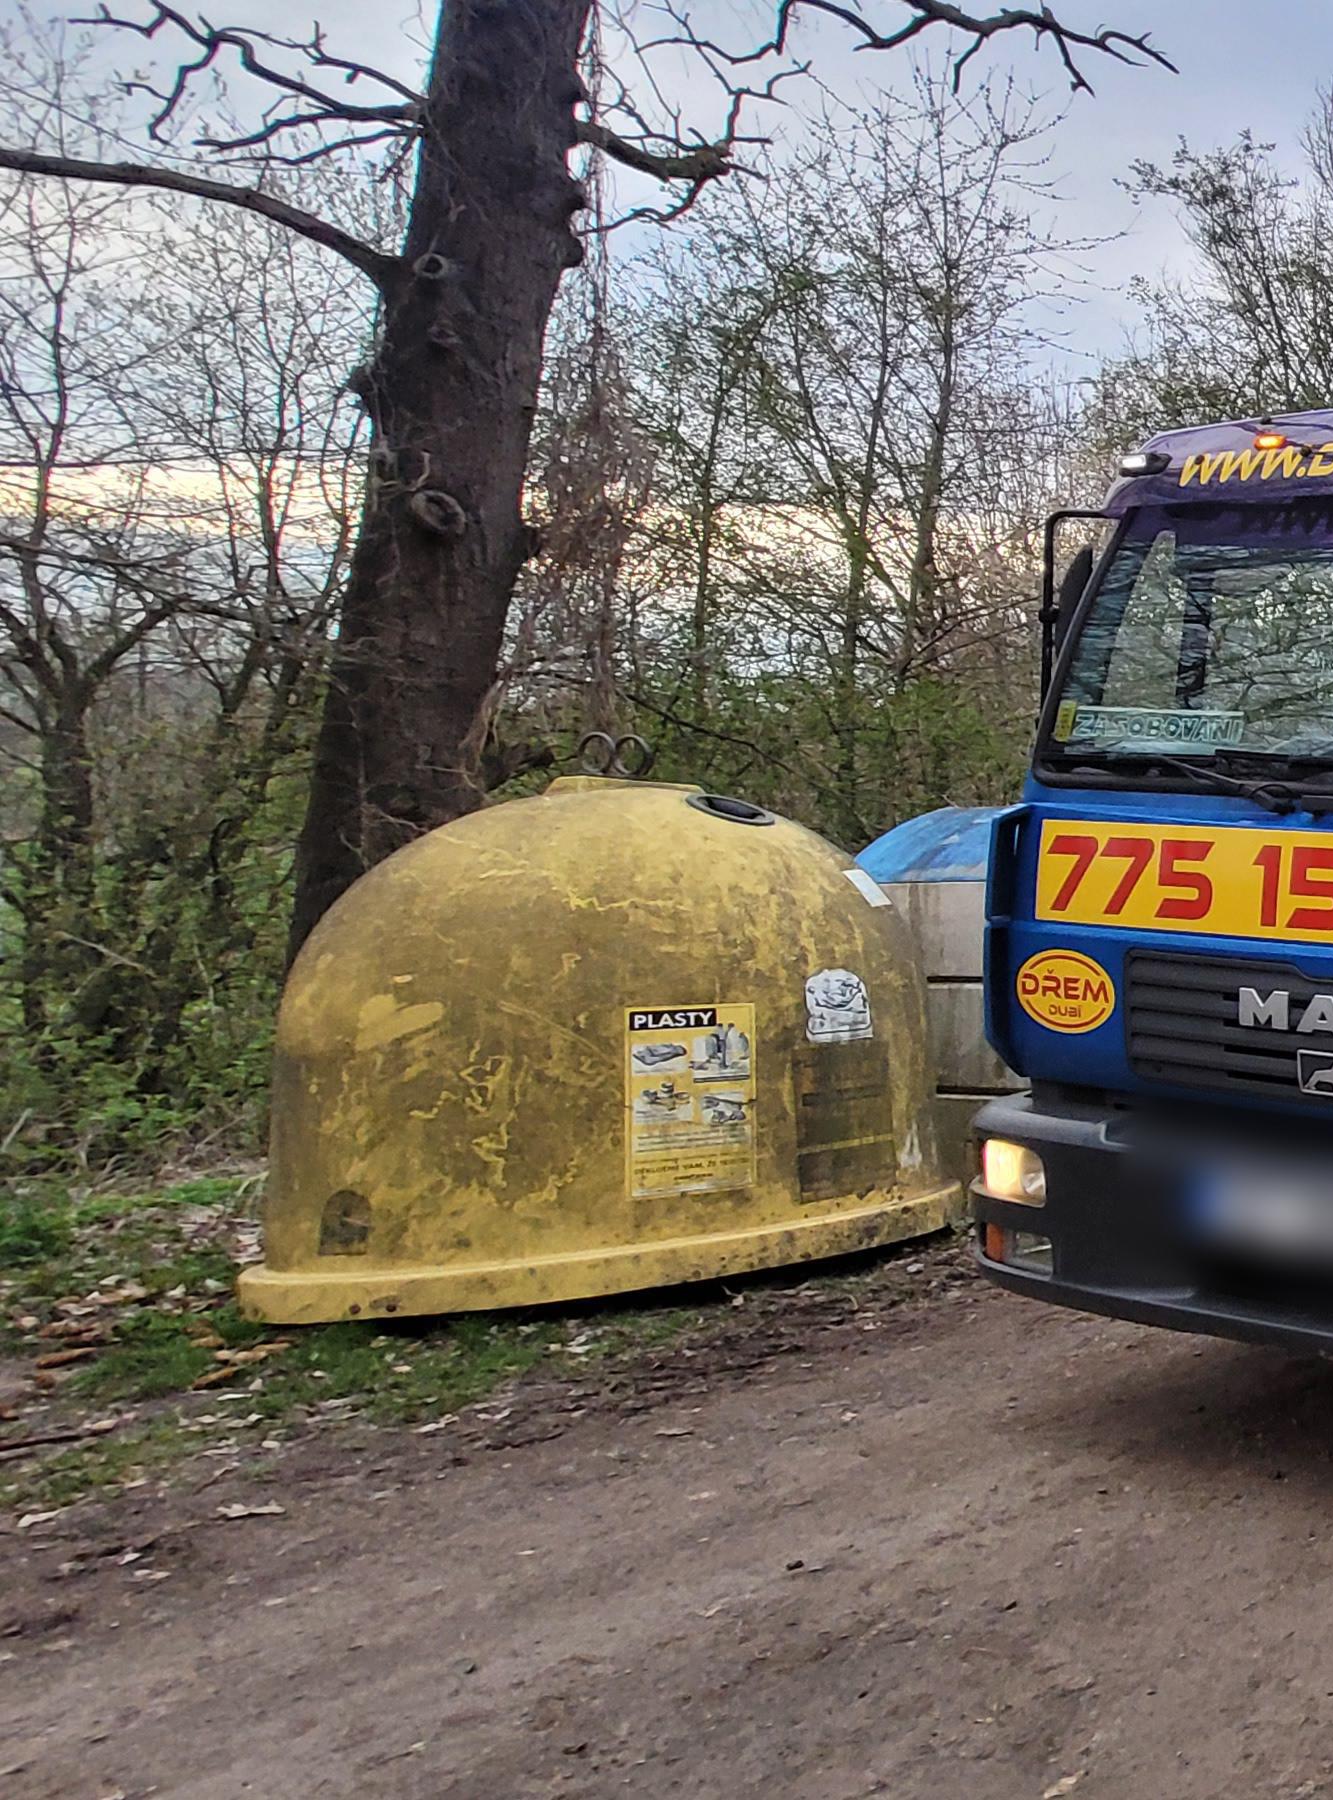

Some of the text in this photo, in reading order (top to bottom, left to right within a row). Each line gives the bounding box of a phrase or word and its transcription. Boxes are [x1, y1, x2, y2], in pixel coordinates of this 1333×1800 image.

[1046, 835, 1216, 919] 775
[1021, 968, 1110, 1004] DŘEM
[633, 1011, 714, 1029] PLASTY
